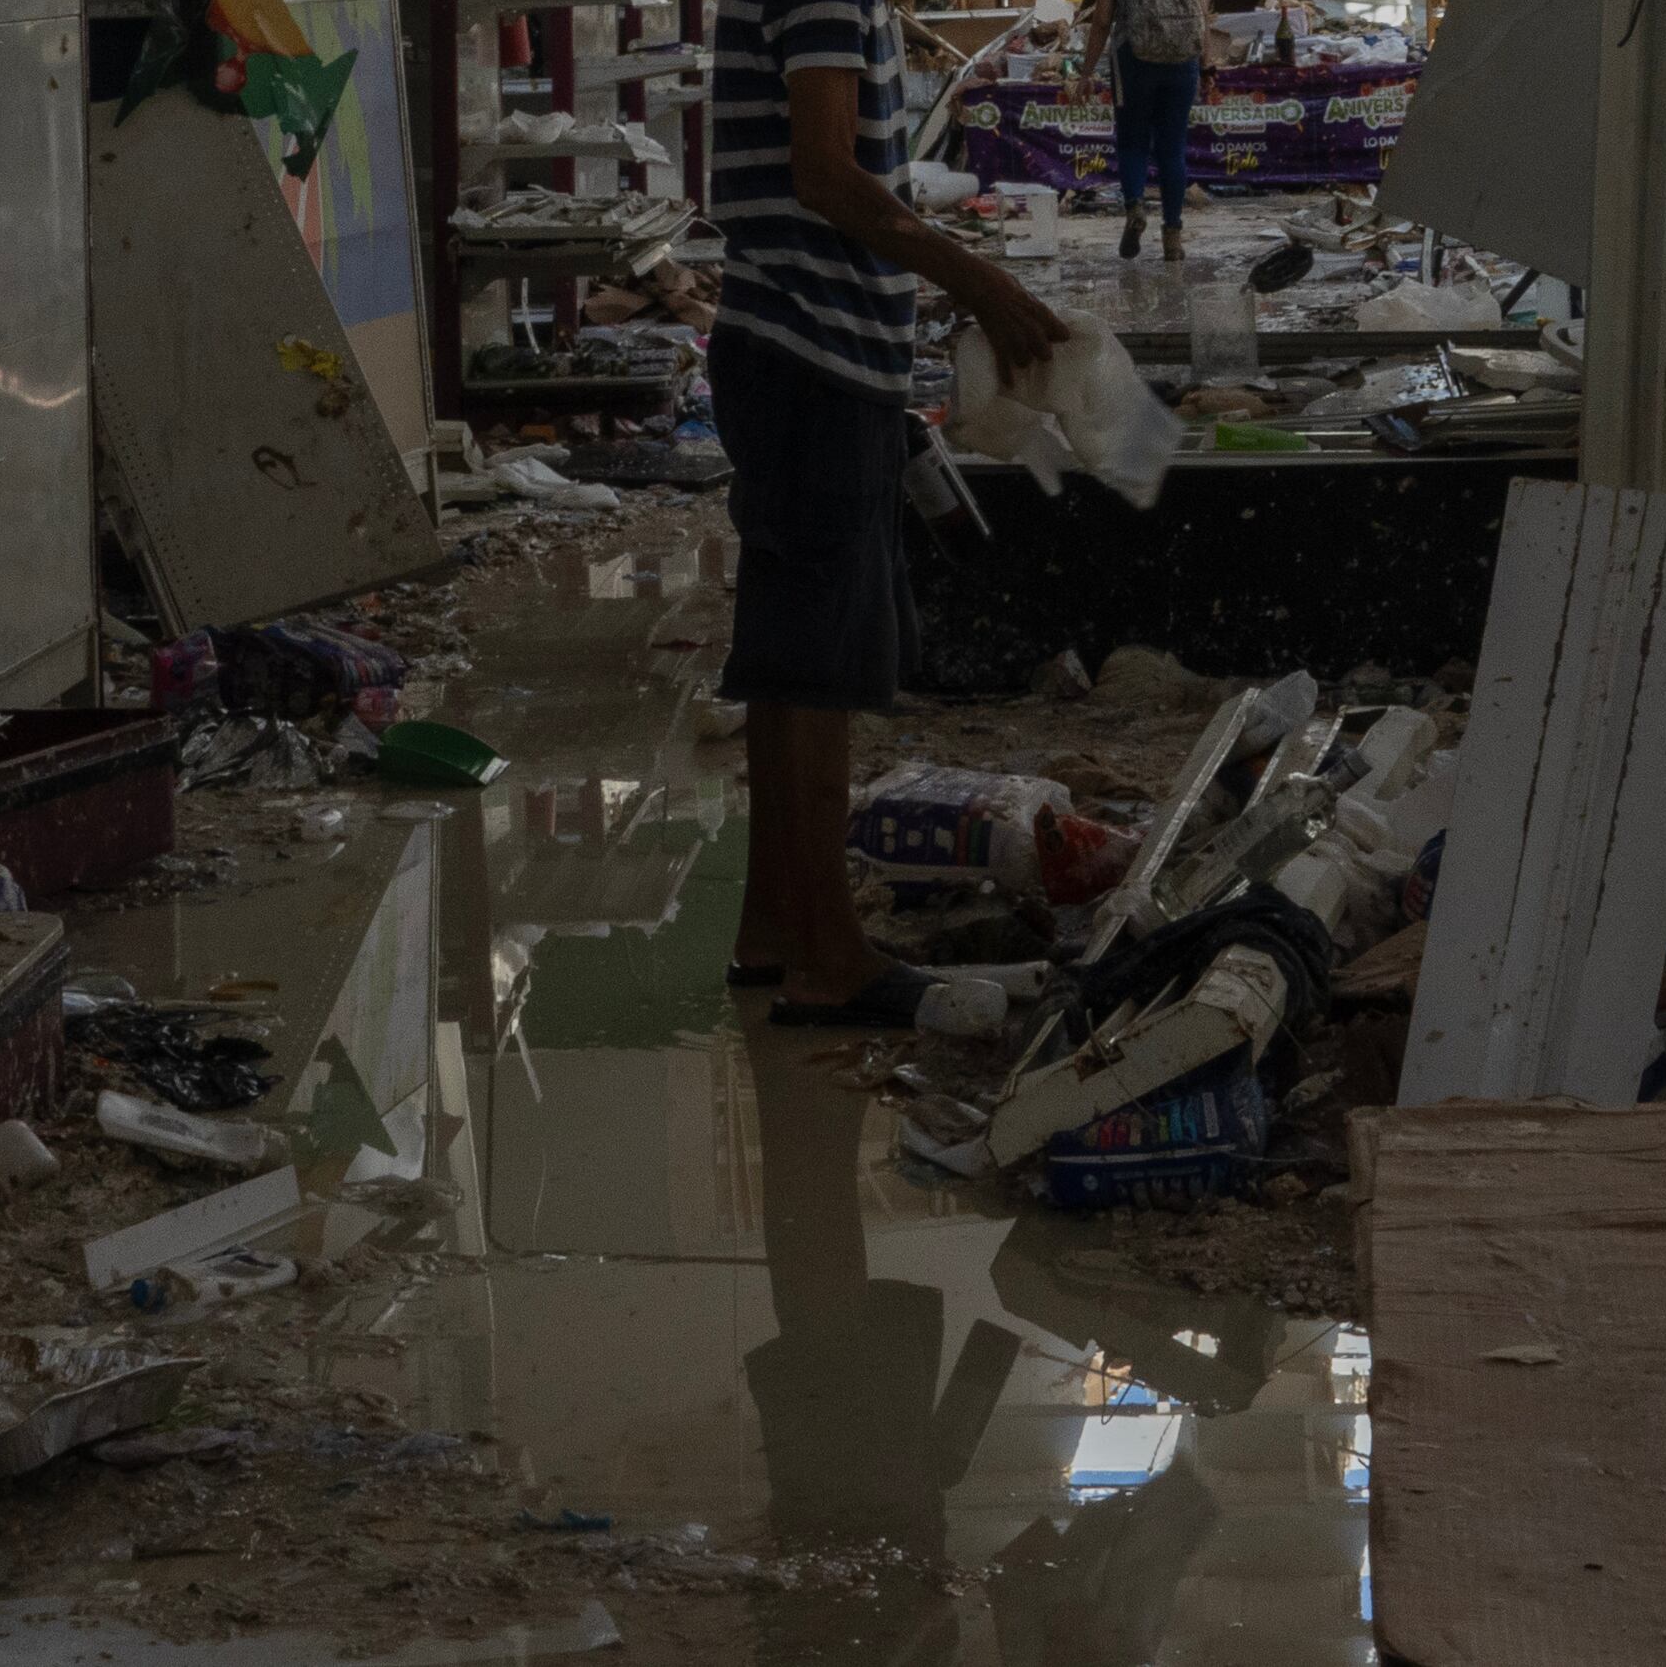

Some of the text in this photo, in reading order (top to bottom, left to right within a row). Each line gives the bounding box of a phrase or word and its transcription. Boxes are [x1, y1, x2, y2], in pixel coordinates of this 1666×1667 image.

[1020, 101, 1112, 129] ANIVERSA
[1326, 97, 1405, 122] ANIVERS
[1060, 144, 1073, 154] LO
[1211, 142, 1268, 153] LO DAMOS
[1364, 137, 1378, 149] LO
